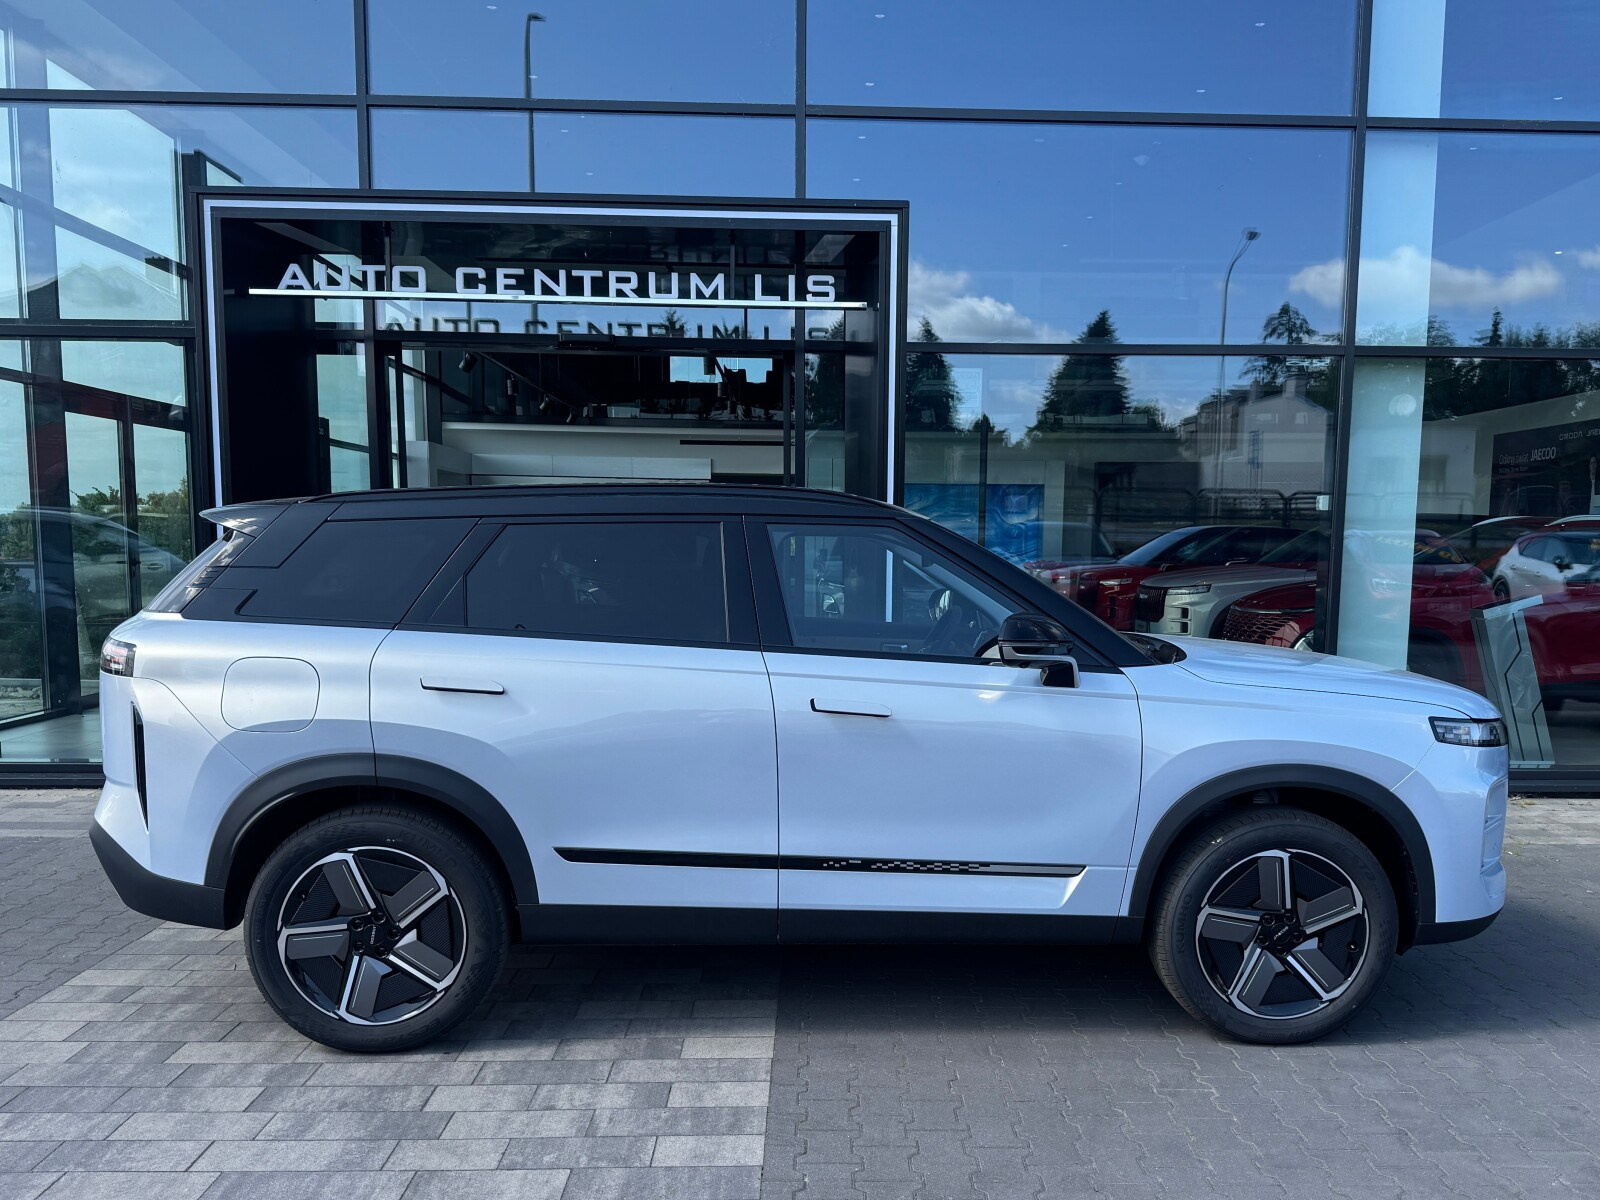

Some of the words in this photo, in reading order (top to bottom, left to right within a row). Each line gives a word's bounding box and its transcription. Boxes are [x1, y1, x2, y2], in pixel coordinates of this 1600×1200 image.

[277, 263, 428, 292] AUTO
[455, 267, 726, 300] CENTRUM
[754, 273, 836, 302] LIS
[1530, 446, 1557, 461] JAECOO
